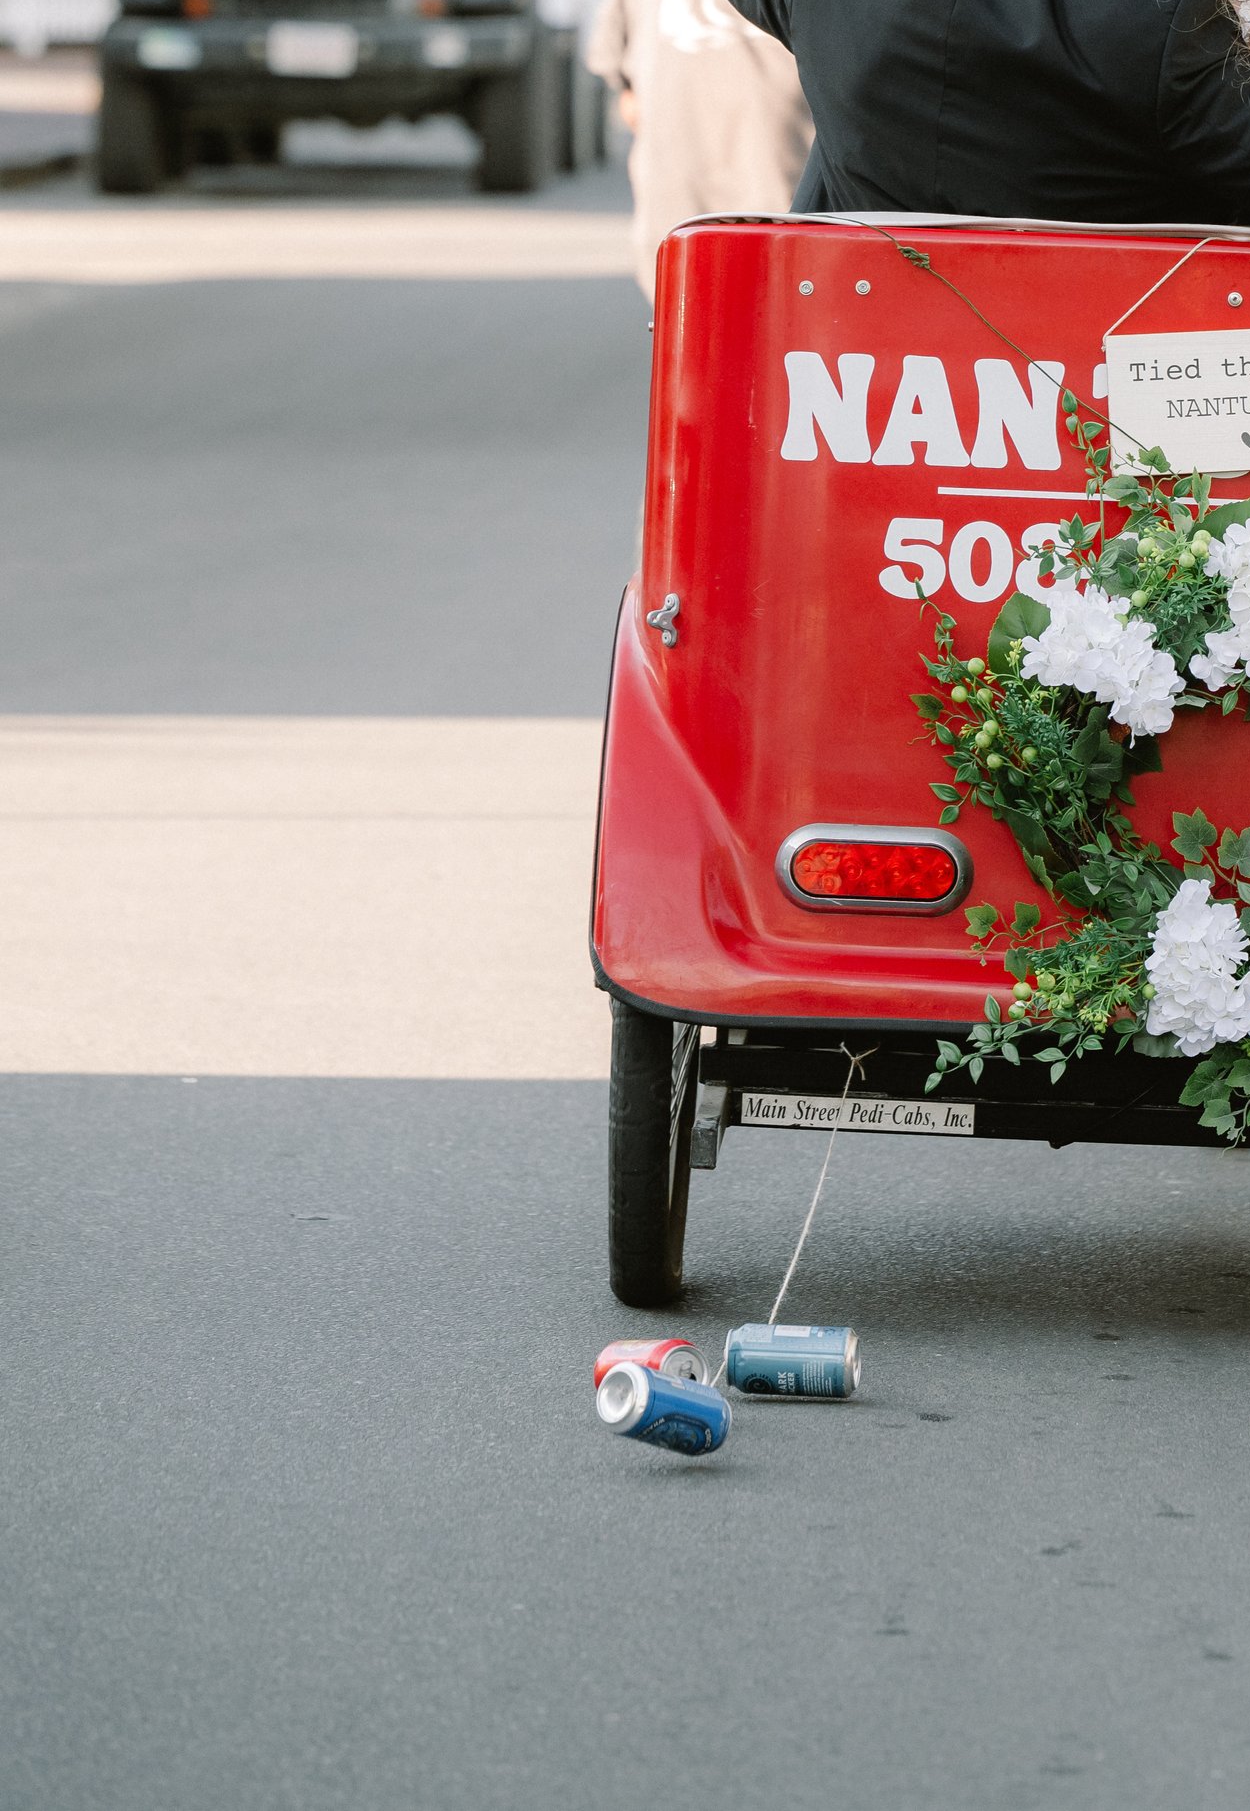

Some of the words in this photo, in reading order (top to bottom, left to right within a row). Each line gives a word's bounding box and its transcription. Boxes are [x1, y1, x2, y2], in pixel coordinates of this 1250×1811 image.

[1130, 358, 1201, 382] Tied
[744, 1098, 786, 1119] Main
[849, 1102, 936, 1130] Pedi-Cabs,
[943, 1107, 973, 1128] Inc.
